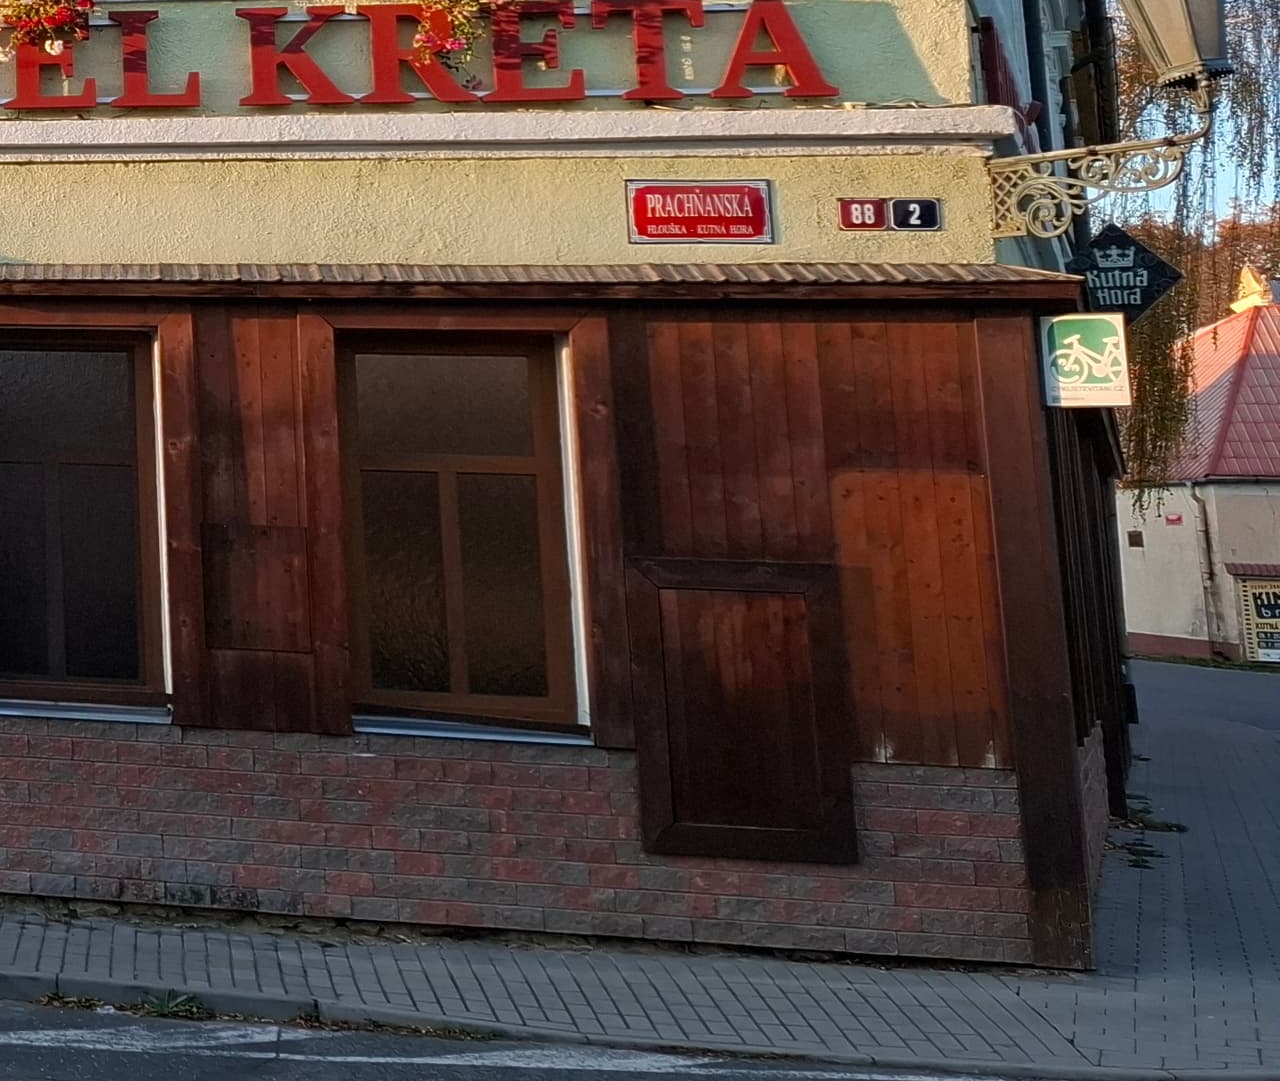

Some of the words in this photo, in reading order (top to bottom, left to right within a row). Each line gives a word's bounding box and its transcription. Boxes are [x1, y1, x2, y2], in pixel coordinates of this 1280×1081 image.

[645, 188, 753, 217] PRACHŇANSKÁ
[850, 204, 875, 225] 88
[908, 204, 922, 225] 2
[647, 222, 687, 234] HLOUŠKA
[697, 222, 727, 234] KUTNÁ
[729, 225, 754, 234] HORA
[1086, 267, 1148, 287] Kutná
[1097, 288, 1142, 306] Hora
